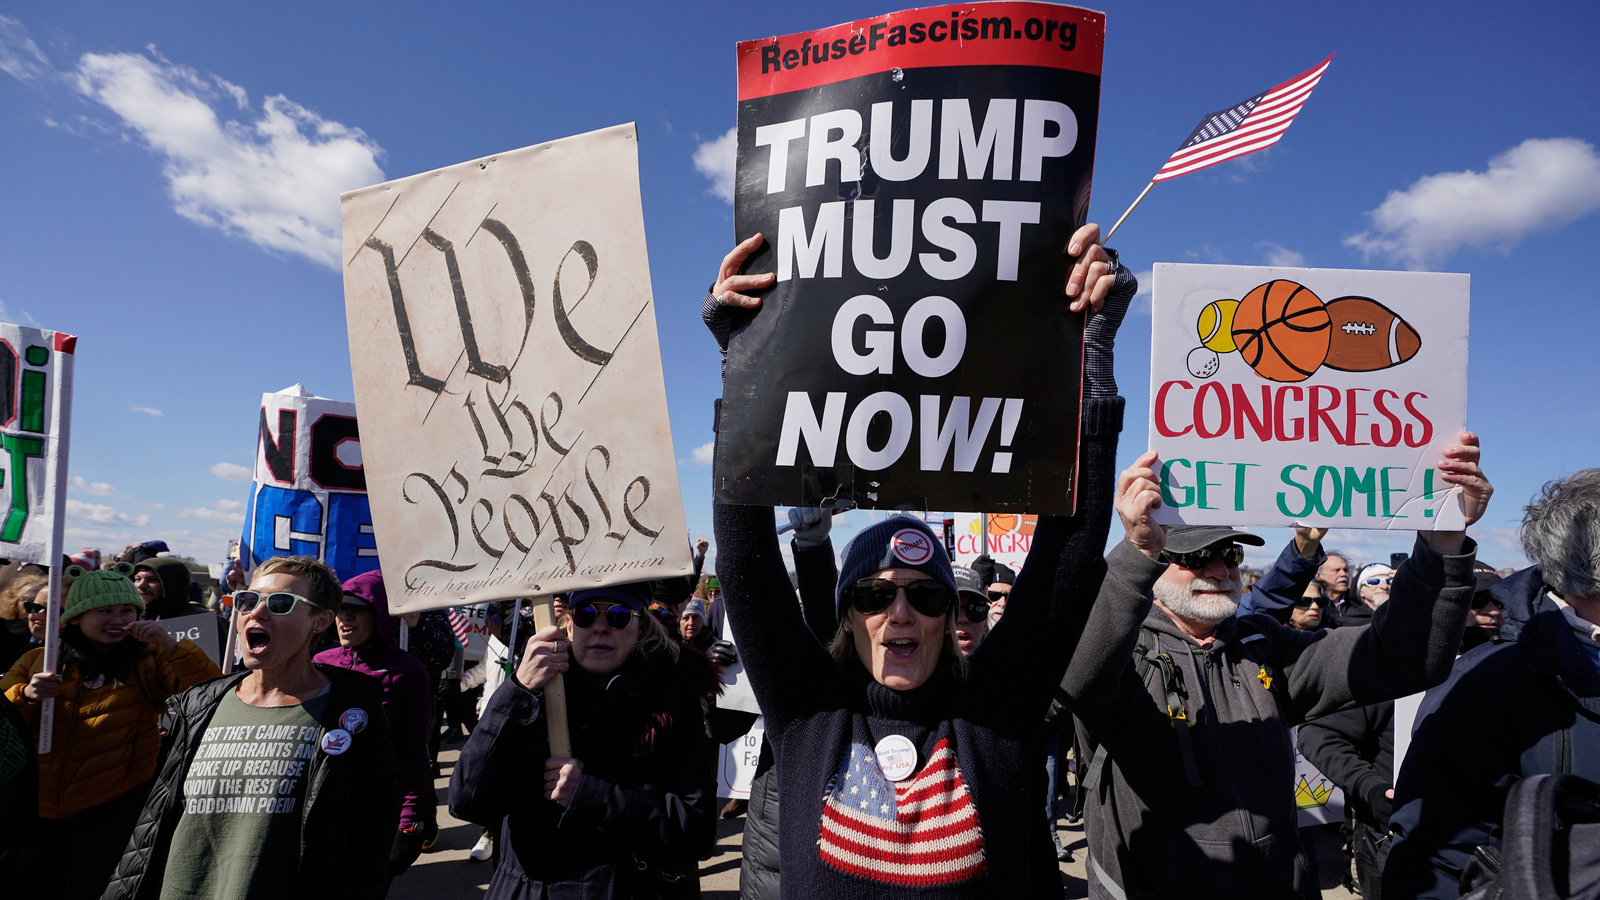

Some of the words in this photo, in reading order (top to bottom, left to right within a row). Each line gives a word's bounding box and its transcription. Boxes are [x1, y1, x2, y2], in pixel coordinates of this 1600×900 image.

[761, 12, 1078, 75] RefuseFascism.org
[755, 98, 1079, 195] TRUMP
[776, 197, 1042, 283] MUST
[350, 190, 642, 405] We
[831, 294, 967, 378] GO
[775, 391, 1025, 474] NOW!
[1154, 380, 1434, 448] CONGRESS
[402, 445, 662, 582] People
[1158, 458, 1262, 512] GET
[1276, 464, 1435, 519] SOME!
[439, 567, 514, 596] provide
[580, 556, 668, 576] common
[899, 538, 924, 554] TRUMP
[204, 742, 295, 759] IMMIGRANTS
[224, 725, 255, 741] THEY
[255, 725, 297, 741] CAME
[744, 734, 757, 747] to
[219, 779, 242, 795] THE
[243, 778, 279, 795] REST
[277, 779, 298, 796] OF
[221, 760, 242, 777] UP
[242, 760, 305, 777] BECAUSE
[188, 797, 258, 815] GODDAMN
[256, 797, 297, 815] POEM
